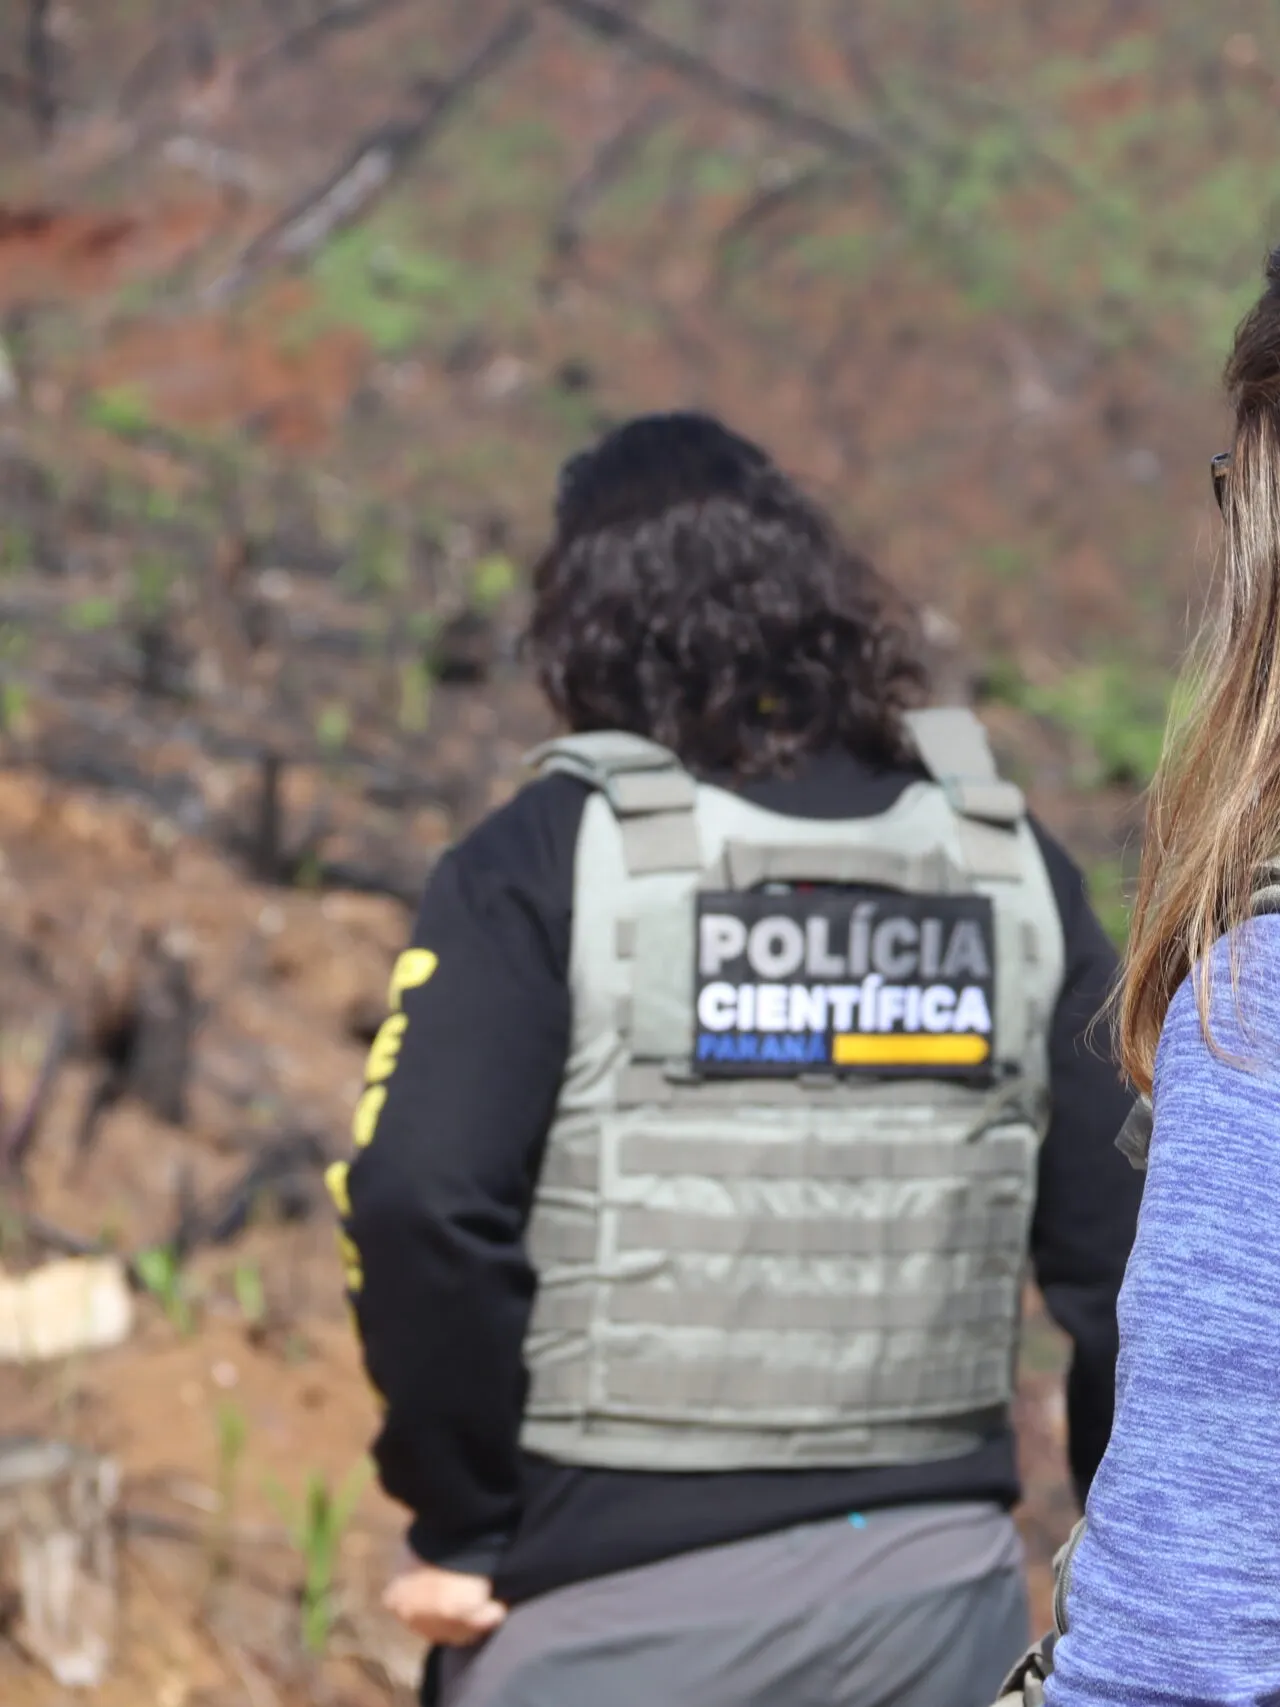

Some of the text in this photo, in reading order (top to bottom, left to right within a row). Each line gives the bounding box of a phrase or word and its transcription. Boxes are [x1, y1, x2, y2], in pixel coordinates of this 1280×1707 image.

[699, 903, 990, 978] POLÍCIA
[698, 973, 991, 1032] CIENTÍFICA
[699, 1030, 826, 1061] PARANÁ
